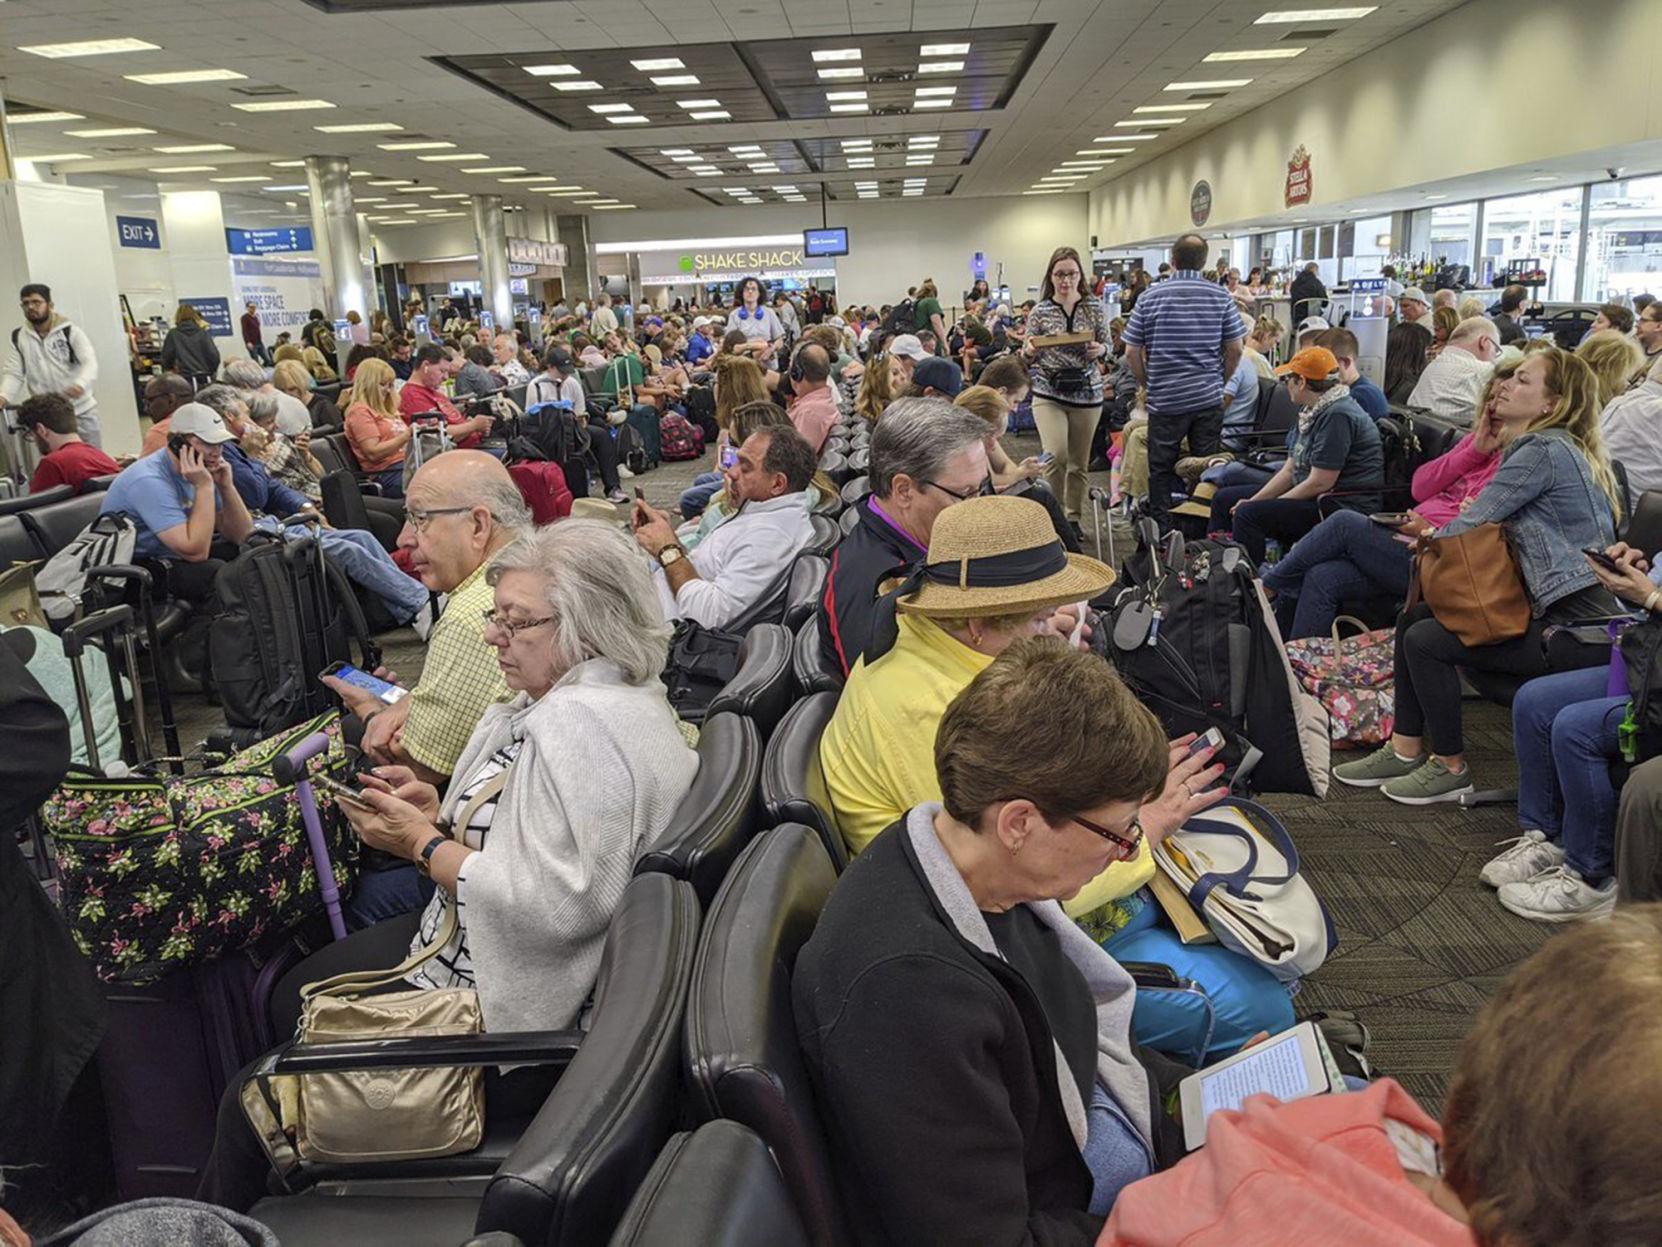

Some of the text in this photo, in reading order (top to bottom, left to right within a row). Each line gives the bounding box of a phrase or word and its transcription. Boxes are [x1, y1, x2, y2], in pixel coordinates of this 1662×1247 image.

[122, 223, 143, 240] EXIT
[694, 250, 803, 270] SHAKE SHACK
[1361, 280, 1387, 289] DELTA
[262, 312, 281, 327] MORE
